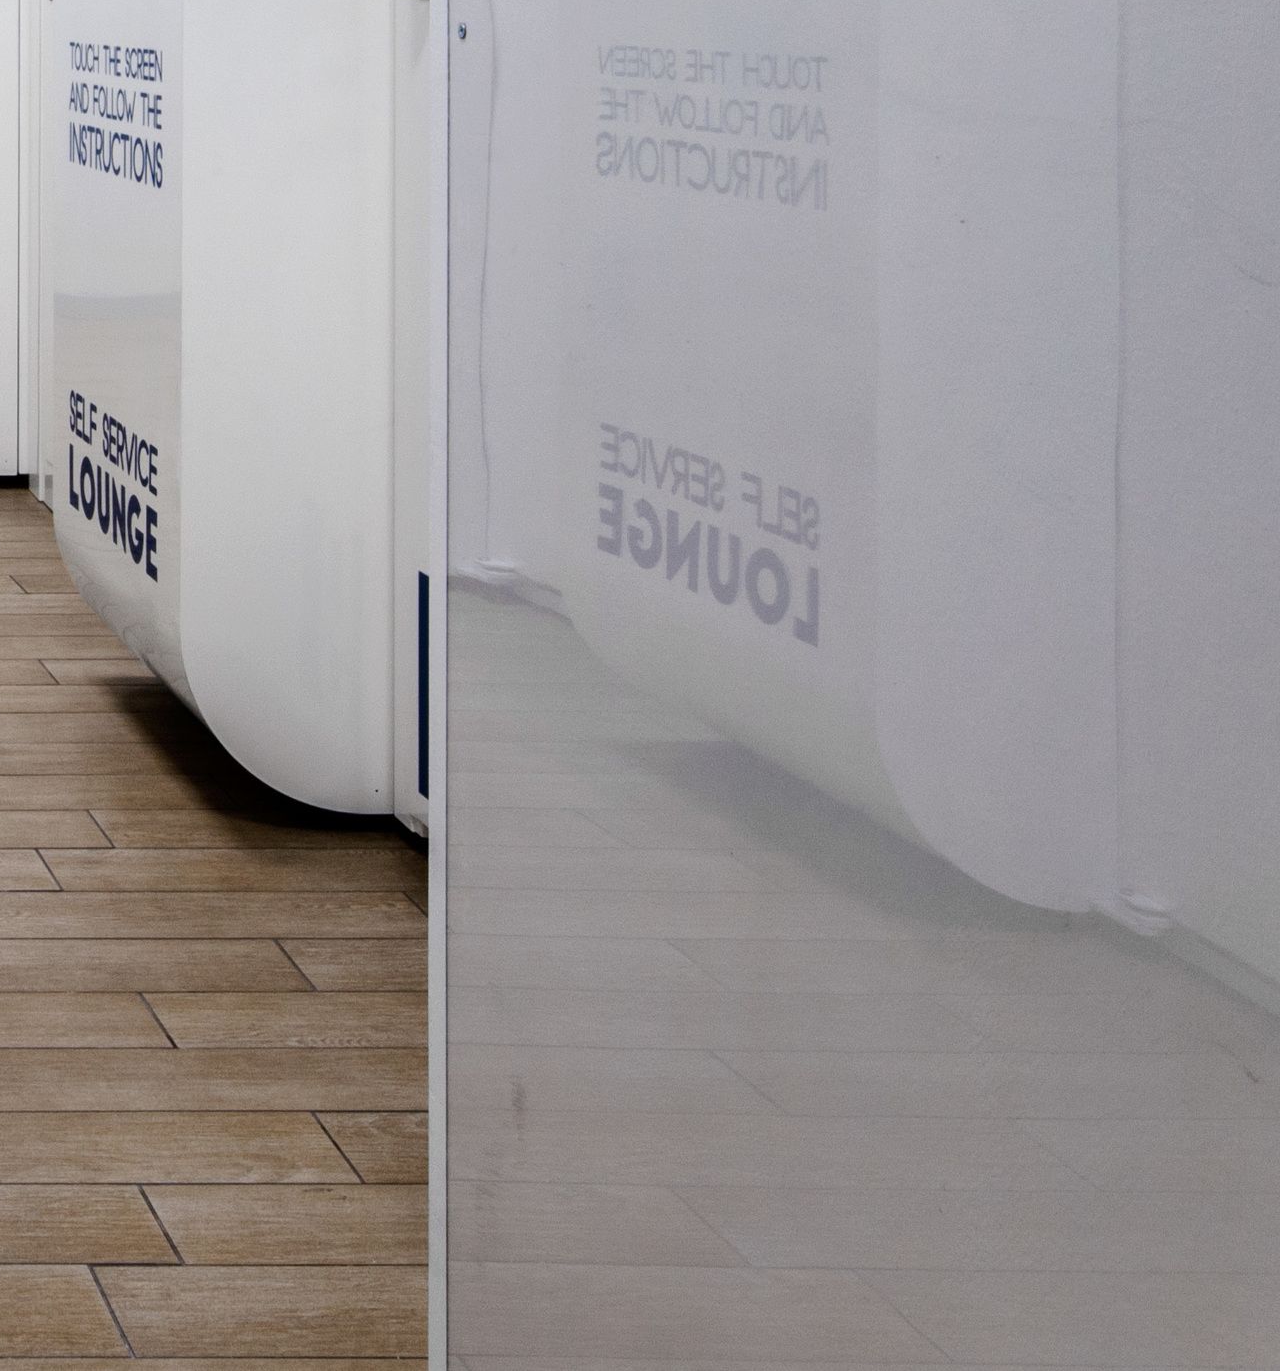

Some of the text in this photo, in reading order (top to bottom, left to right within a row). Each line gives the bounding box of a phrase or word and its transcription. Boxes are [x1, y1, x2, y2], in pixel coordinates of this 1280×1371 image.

[69, 41, 163, 82] TOUCH THE SCREEN
[69, 81, 163, 130] AND FOLLOW THE
[69, 121, 164, 189] INSTRUCTIONS
[69, 389, 158, 497] SELF SERVICE
[69, 443, 159, 583] LOUNGE
